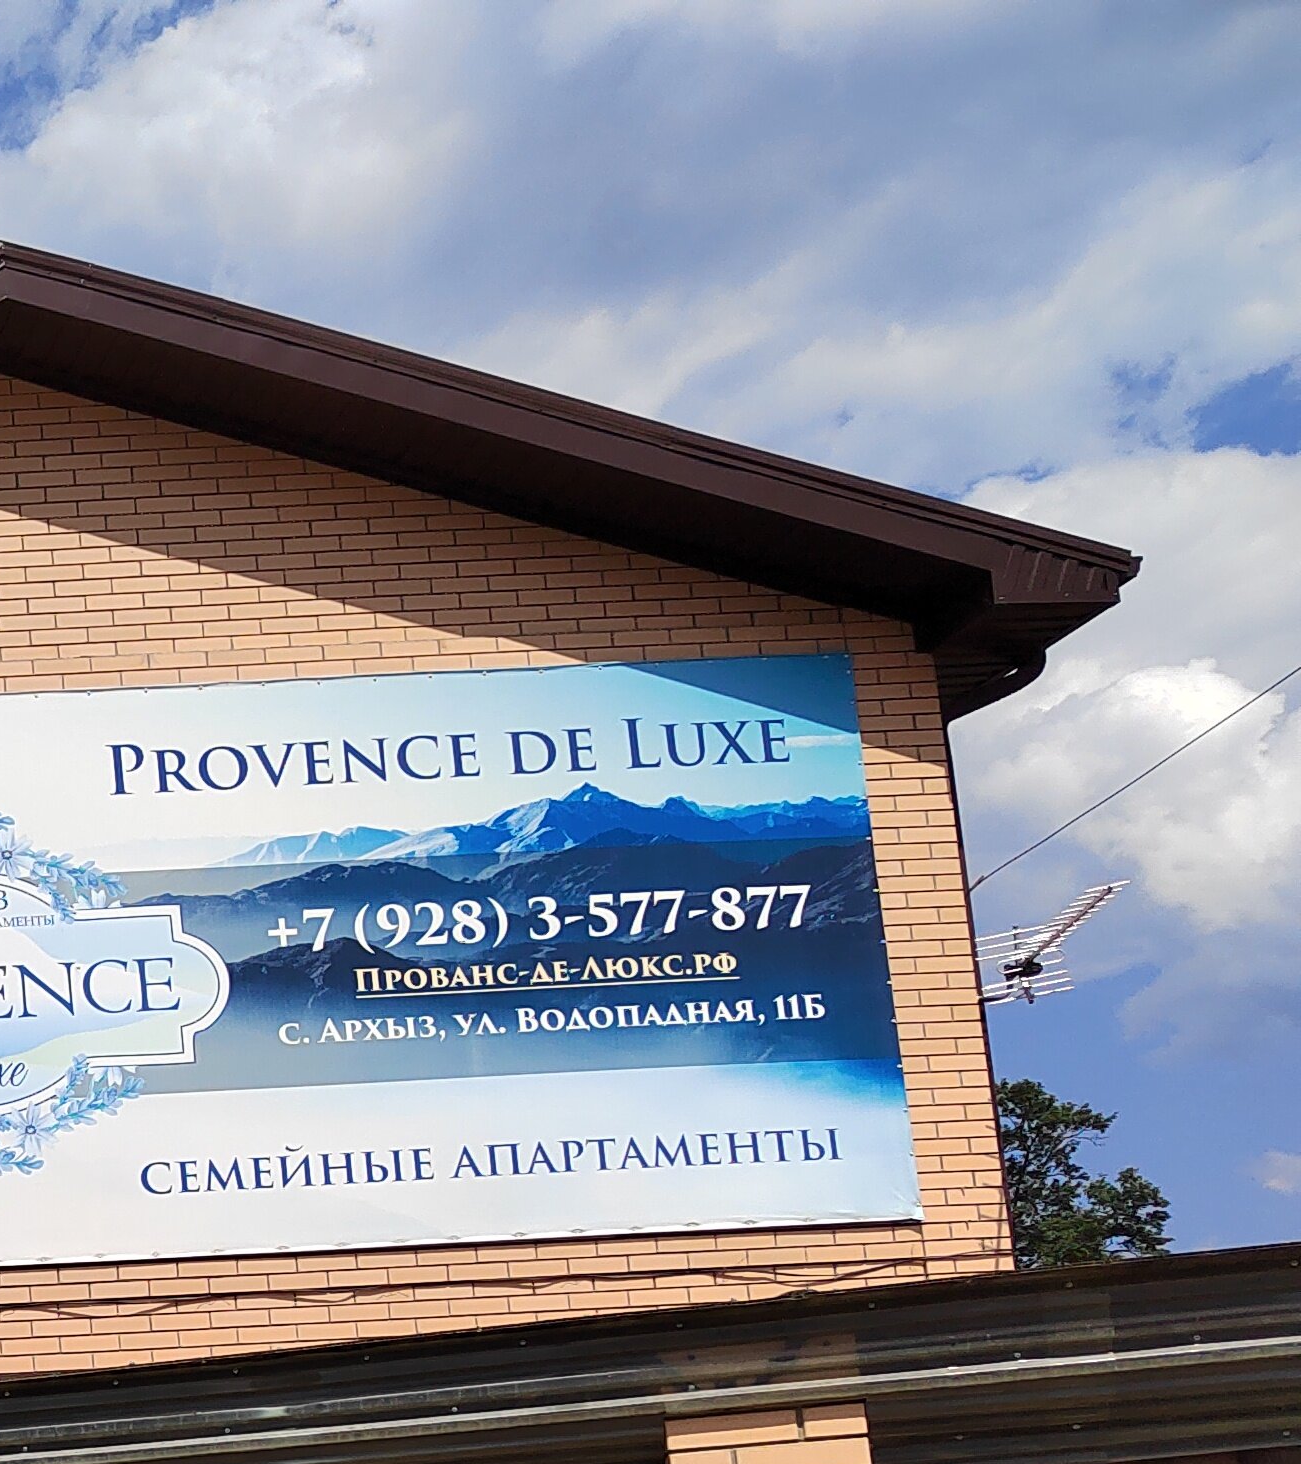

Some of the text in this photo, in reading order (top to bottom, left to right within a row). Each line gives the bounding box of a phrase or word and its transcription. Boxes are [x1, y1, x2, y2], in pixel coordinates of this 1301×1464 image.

[108, 717, 791, 796] PROVENCE DE LUXE
[267, 883, 812, 955] +7 (928) 3-577-877
[354, 951, 739, 994] ПРОВАНС-ДЕ-ЛЮКС.РФ
[317, 1015, 446, 1044] АРХЫЗ,
[517, 1000, 766, 1035] ВОДОПАДНАЯ,
[774, 993, 827, 1021] 11Б
[139, 1127, 843, 1197] СЕМЕЙНЫЕ АПАРТАМЕНТЫ
